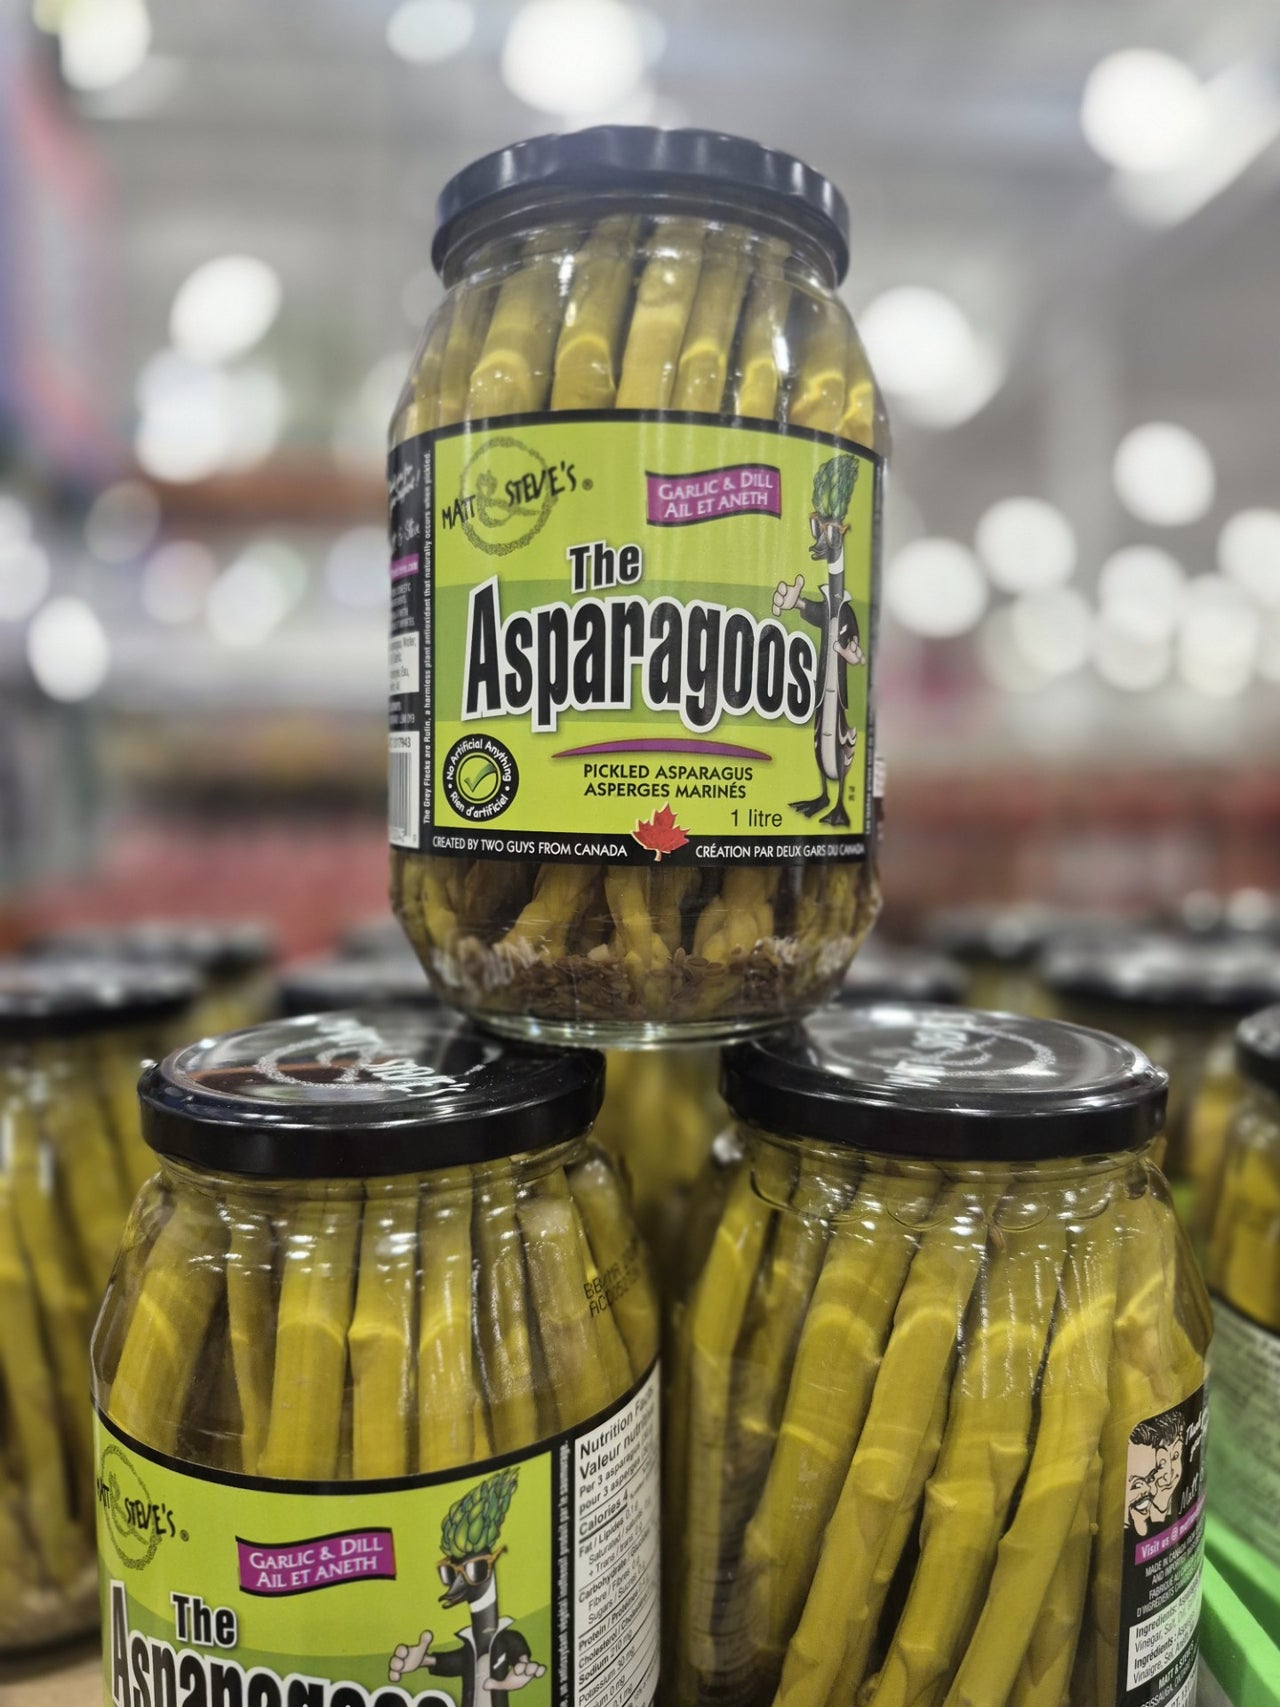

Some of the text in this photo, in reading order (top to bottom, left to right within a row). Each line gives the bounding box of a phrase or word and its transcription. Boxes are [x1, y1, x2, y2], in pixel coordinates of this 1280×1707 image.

[442, 494, 476, 530] MATT
[505, 460, 577, 507] STEVE'S
[658, 471, 773, 500] GARLIC & DILL
[664, 491, 768, 518] AIL ET ANETH
[423, 541, 432, 578] naturally
[567, 541, 642, 593] The
[423, 580, 431, 596] that
[423, 599, 431, 645] antioxidant
[423, 647, 432, 668] plant
[463, 577, 816, 731] Asparagoos
[423, 670, 431, 708] harmless
[423, 760, 431, 786] Flecks
[446, 738, 512, 782] No Artificial Anything
[583, 764, 753, 781] PICKLED ASPARAGUS
[423, 788, 432, 807] Grey
[450, 791, 509, 818] Rien d'artificiel
[583, 781, 746, 799] ASPERGES MARINÉS
[423, 810, 431, 824] The
[730, 808, 782, 828] 1 litre
[432, 835, 466, 850] CREATED
[467, 838, 479, 851] BY
[481, 839, 504, 853] TWO
[506, 840, 535, 854] GUYS
[538, 842, 571, 855] FROM
[574, 843, 628, 857] CANADA
[695, 842, 751, 858] CRÉATION
[754, 845, 774, 857] PAR
[776, 845, 801, 857] DEUX
[803, 844, 826, 857] GARS
[580, 1412, 633, 1460] Nutrition
[580, 1441, 621, 1480] Valeur
[579, 1480, 595, 1497] Per
[598, 1474, 603, 1486] 3
[579, 1493, 601, 1516] pour
[603, 1486, 609, 1497] 3
[125, 1497, 176, 1538] STEVE'S
[579, 1499, 621, 1536] Calories
[249, 1537, 383, 1570] GARLIC & DILL
[1142, 1540, 1160, 1558] Visit
[256, 1556, 377, 1588] AIL ET ANETH
[171, 1592, 237, 1647] The
[579, 1624, 607, 1651] Protein
[579, 1655, 609, 1685] Sodium
[579, 1668, 616, 1706] Potassium
